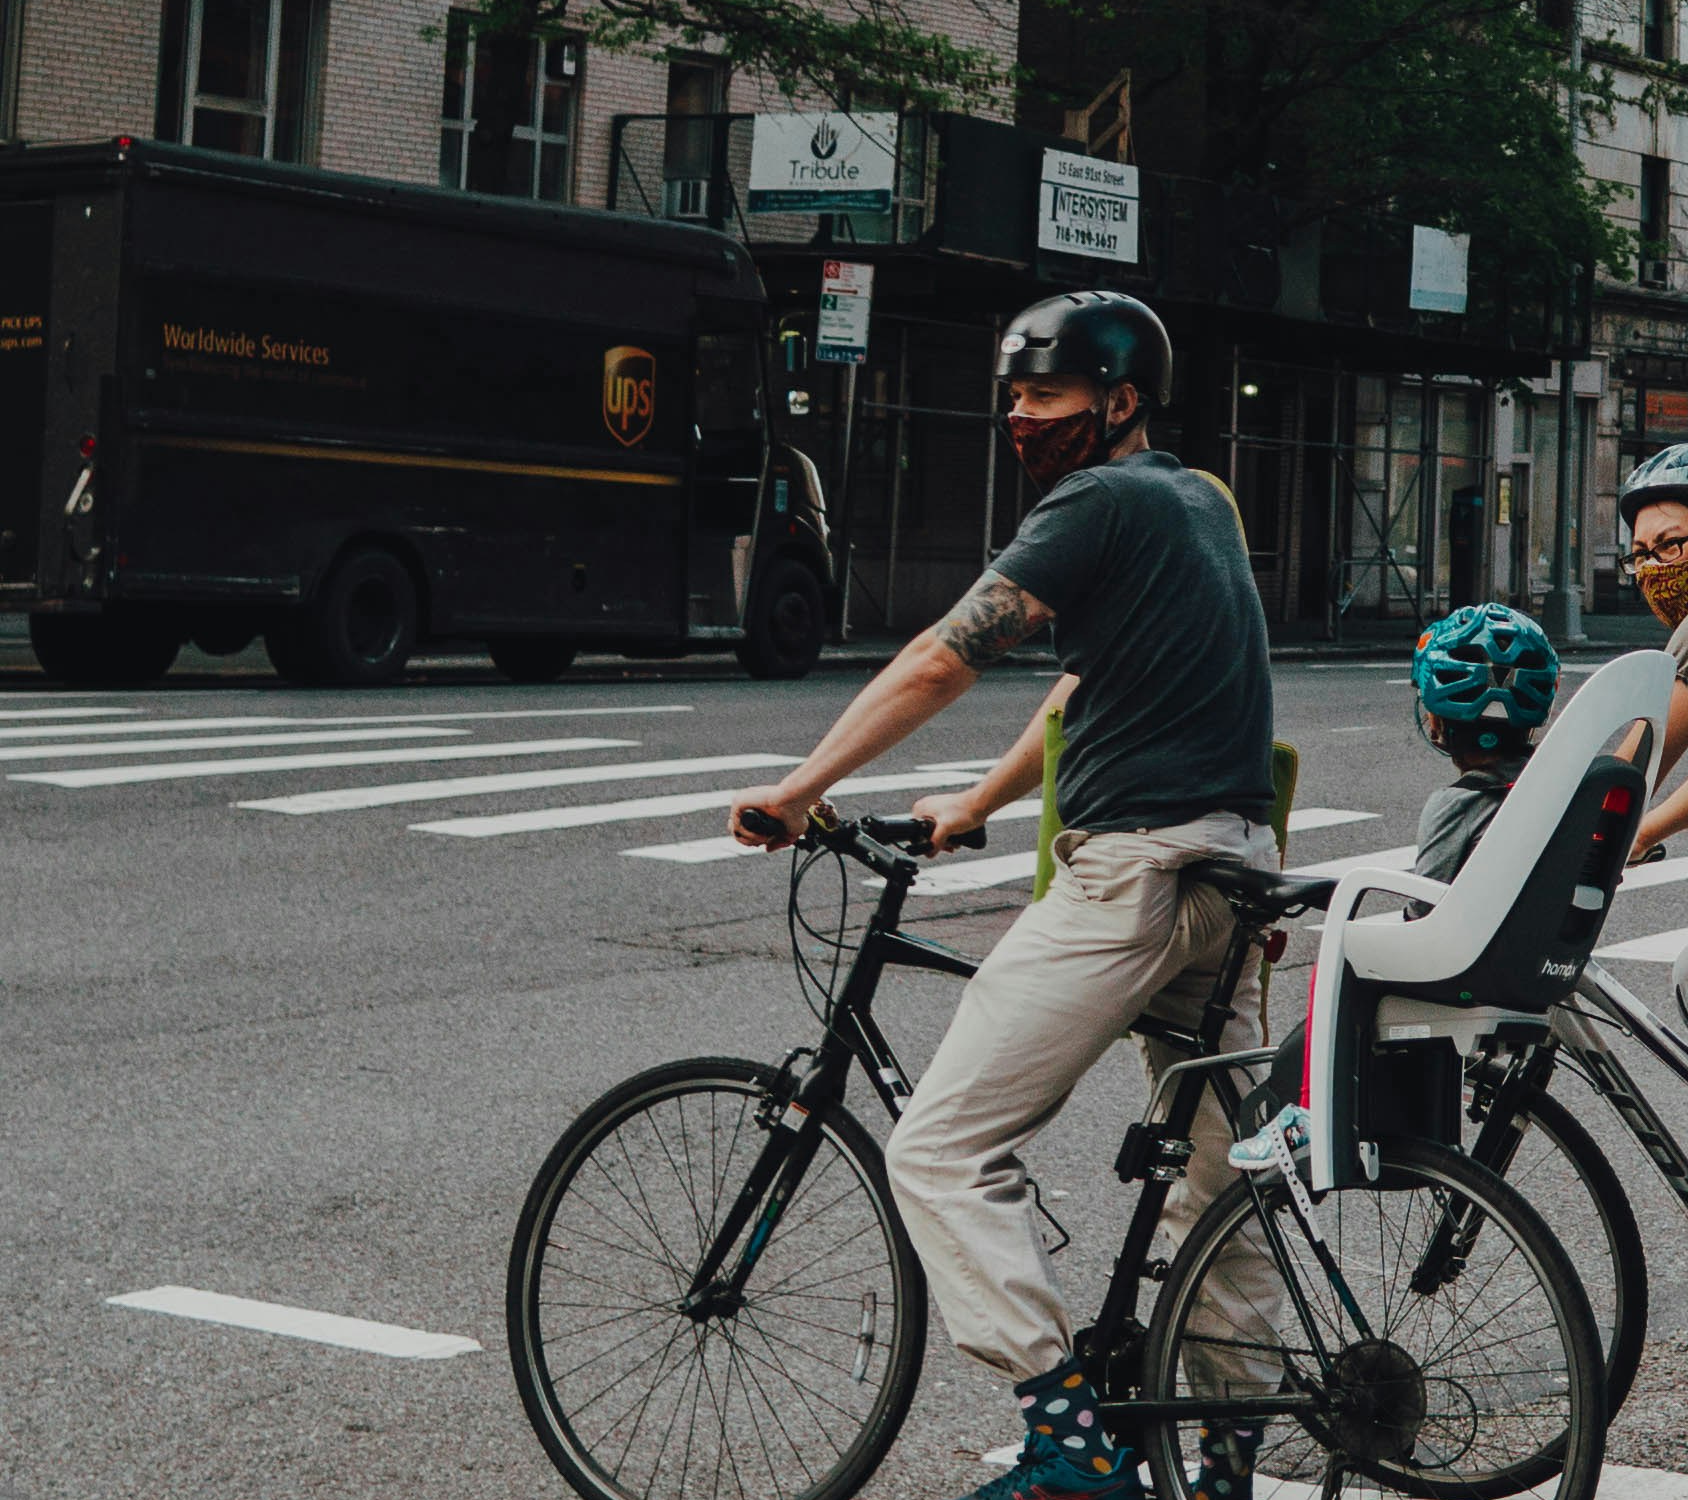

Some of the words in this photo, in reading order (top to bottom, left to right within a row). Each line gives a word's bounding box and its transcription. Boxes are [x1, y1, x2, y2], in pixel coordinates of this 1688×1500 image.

[788, 159, 861, 181] Tribute
[1068, 163, 1084, 179] East
[1103, 170, 1125, 187] Street
[1049, 185, 1128, 223] INTERSYSTEM
[162, 322, 256, 358] Worldwide
[260, 334, 330, 366] Services
[607, 373, 650, 431] ups
